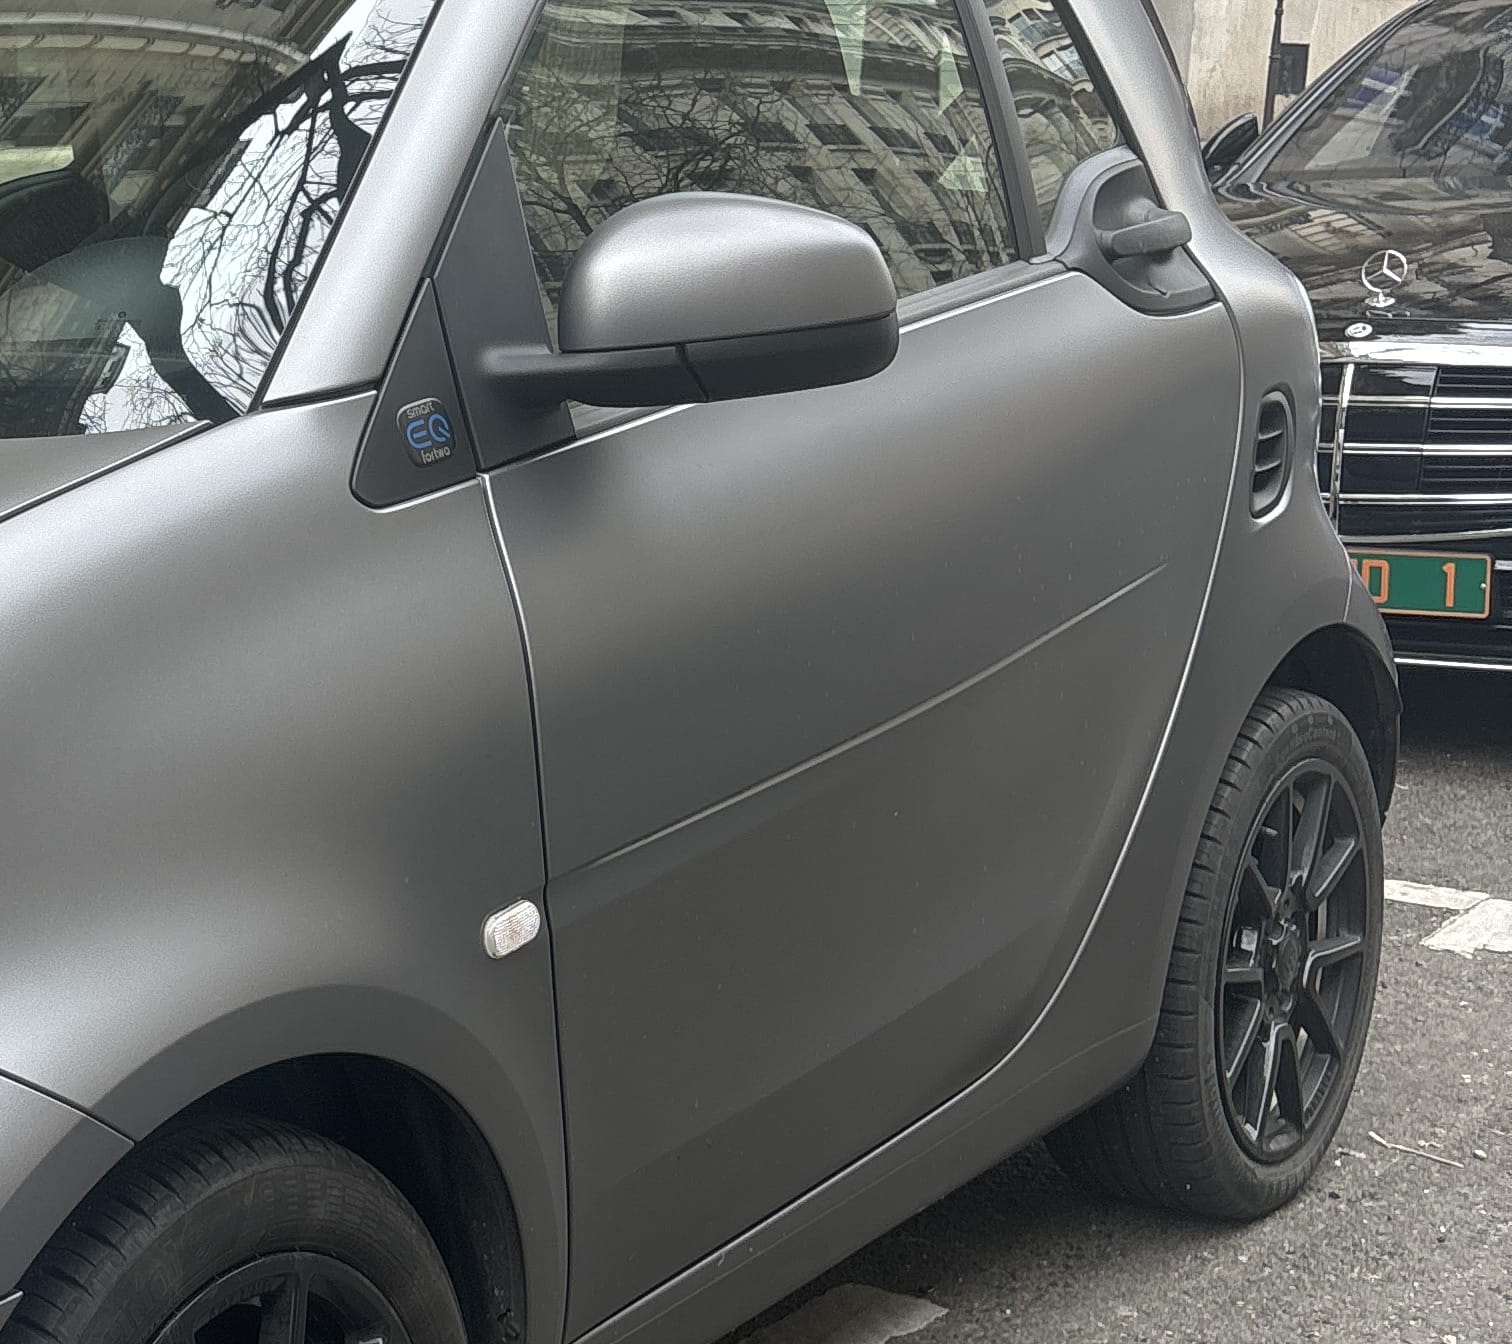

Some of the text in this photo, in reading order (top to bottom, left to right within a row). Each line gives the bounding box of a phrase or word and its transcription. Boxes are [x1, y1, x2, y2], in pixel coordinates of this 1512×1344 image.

[407, 402, 435, 419] smart
[406, 413, 451, 449] EQ
[421, 446, 451, 464] fortwo
[1441, 562, 1456, 608] 1
